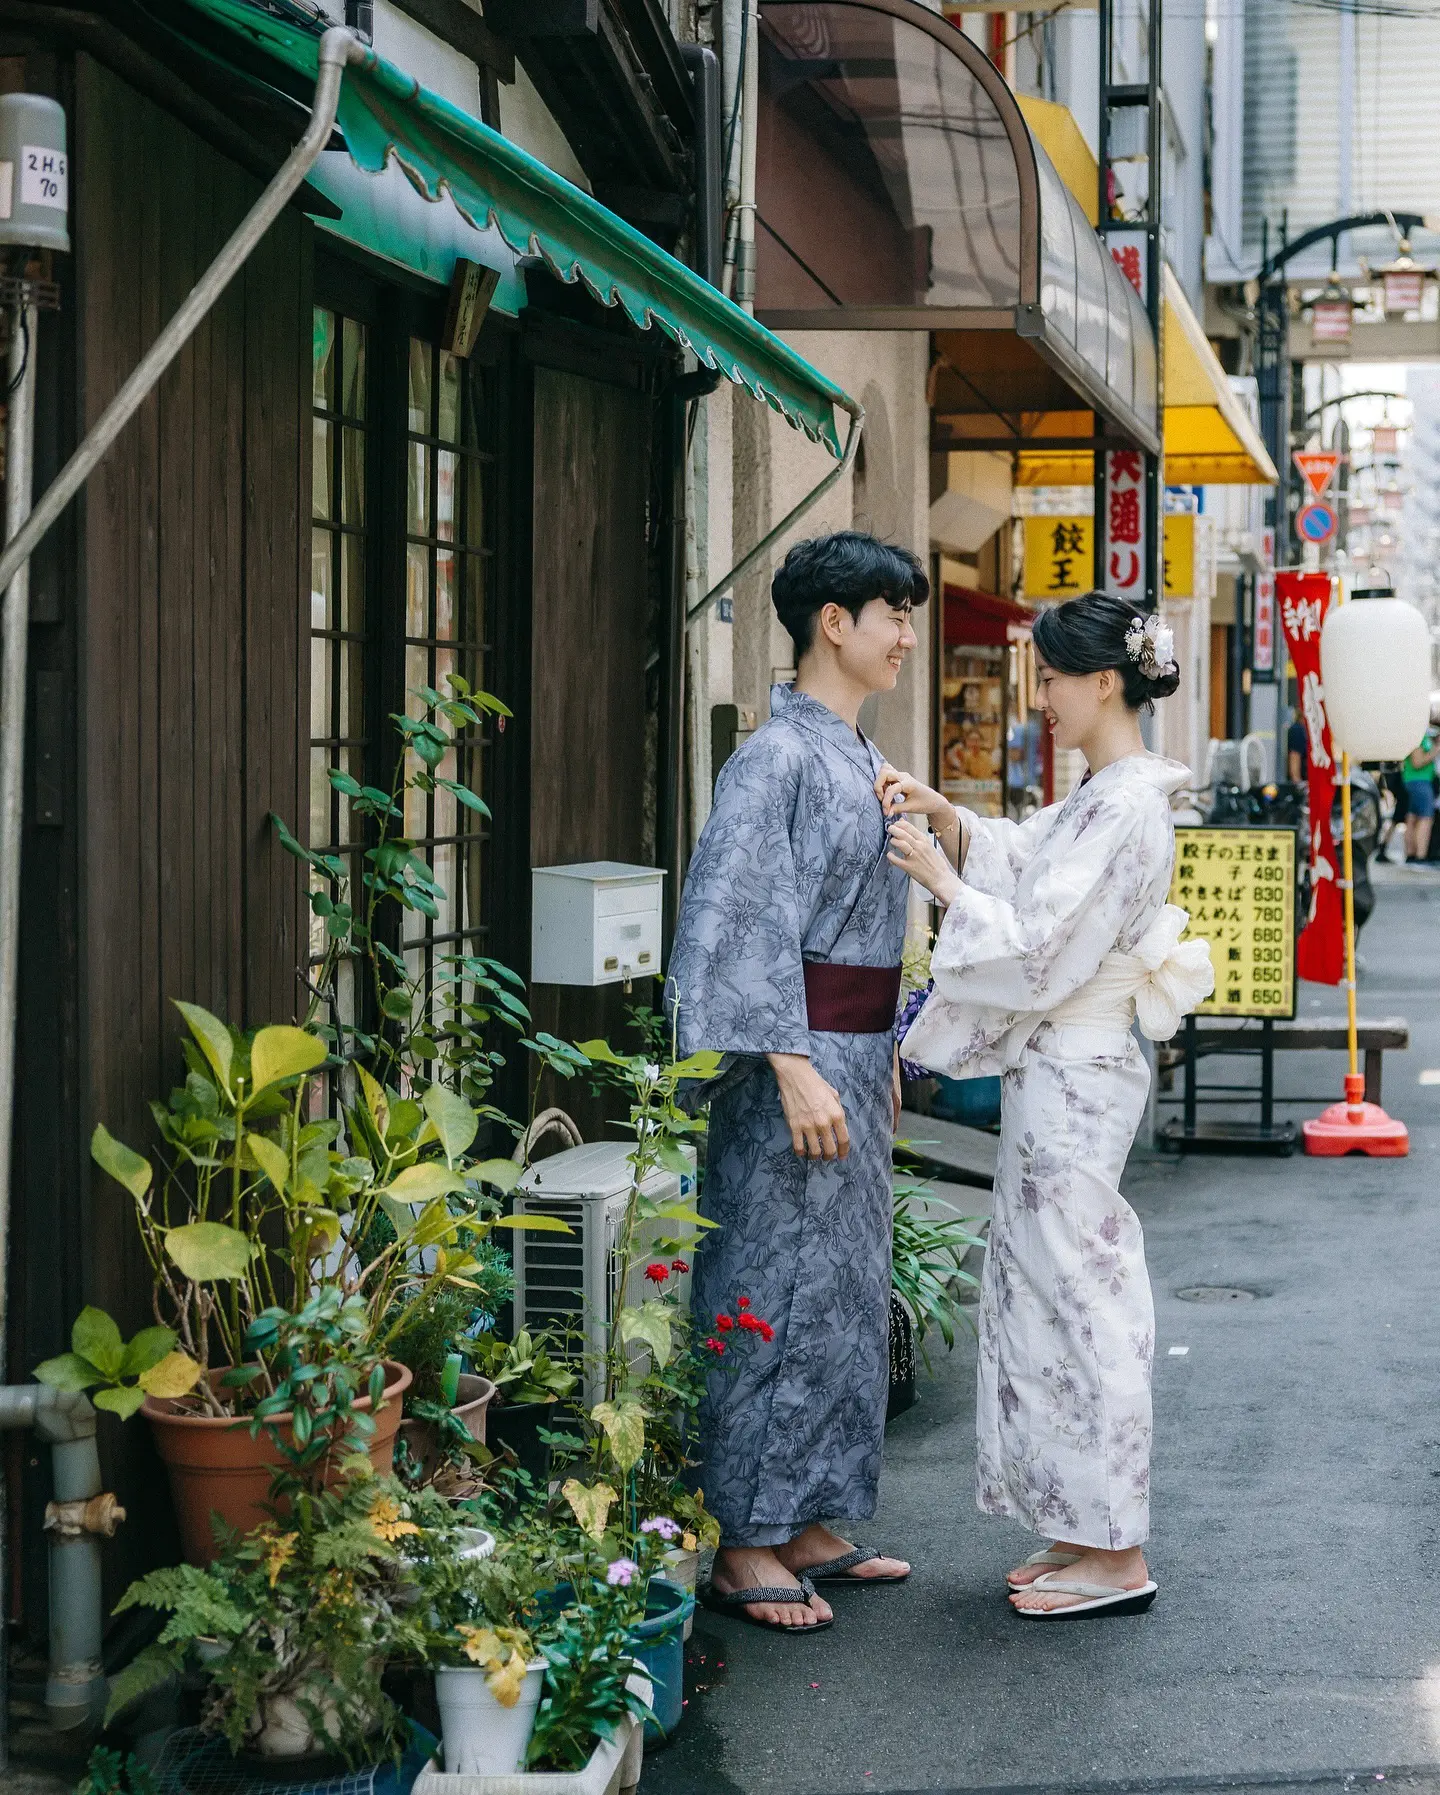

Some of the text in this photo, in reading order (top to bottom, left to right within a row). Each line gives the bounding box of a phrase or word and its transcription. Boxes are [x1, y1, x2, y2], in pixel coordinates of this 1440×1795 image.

[40, 178, 58, 197] 70
[1183, 843, 1279, 861] 餃子の王さま
[1254, 867, 1284, 881] 490
[1254, 886, 1283, 902] 830
[1253, 906, 1283, 922] 780
[1253, 927, 1283, 943] 680
[1252, 947, 1282, 963] 930
[1252, 967, 1282, 983] 650
[1252, 988, 1281, 1004] 650
